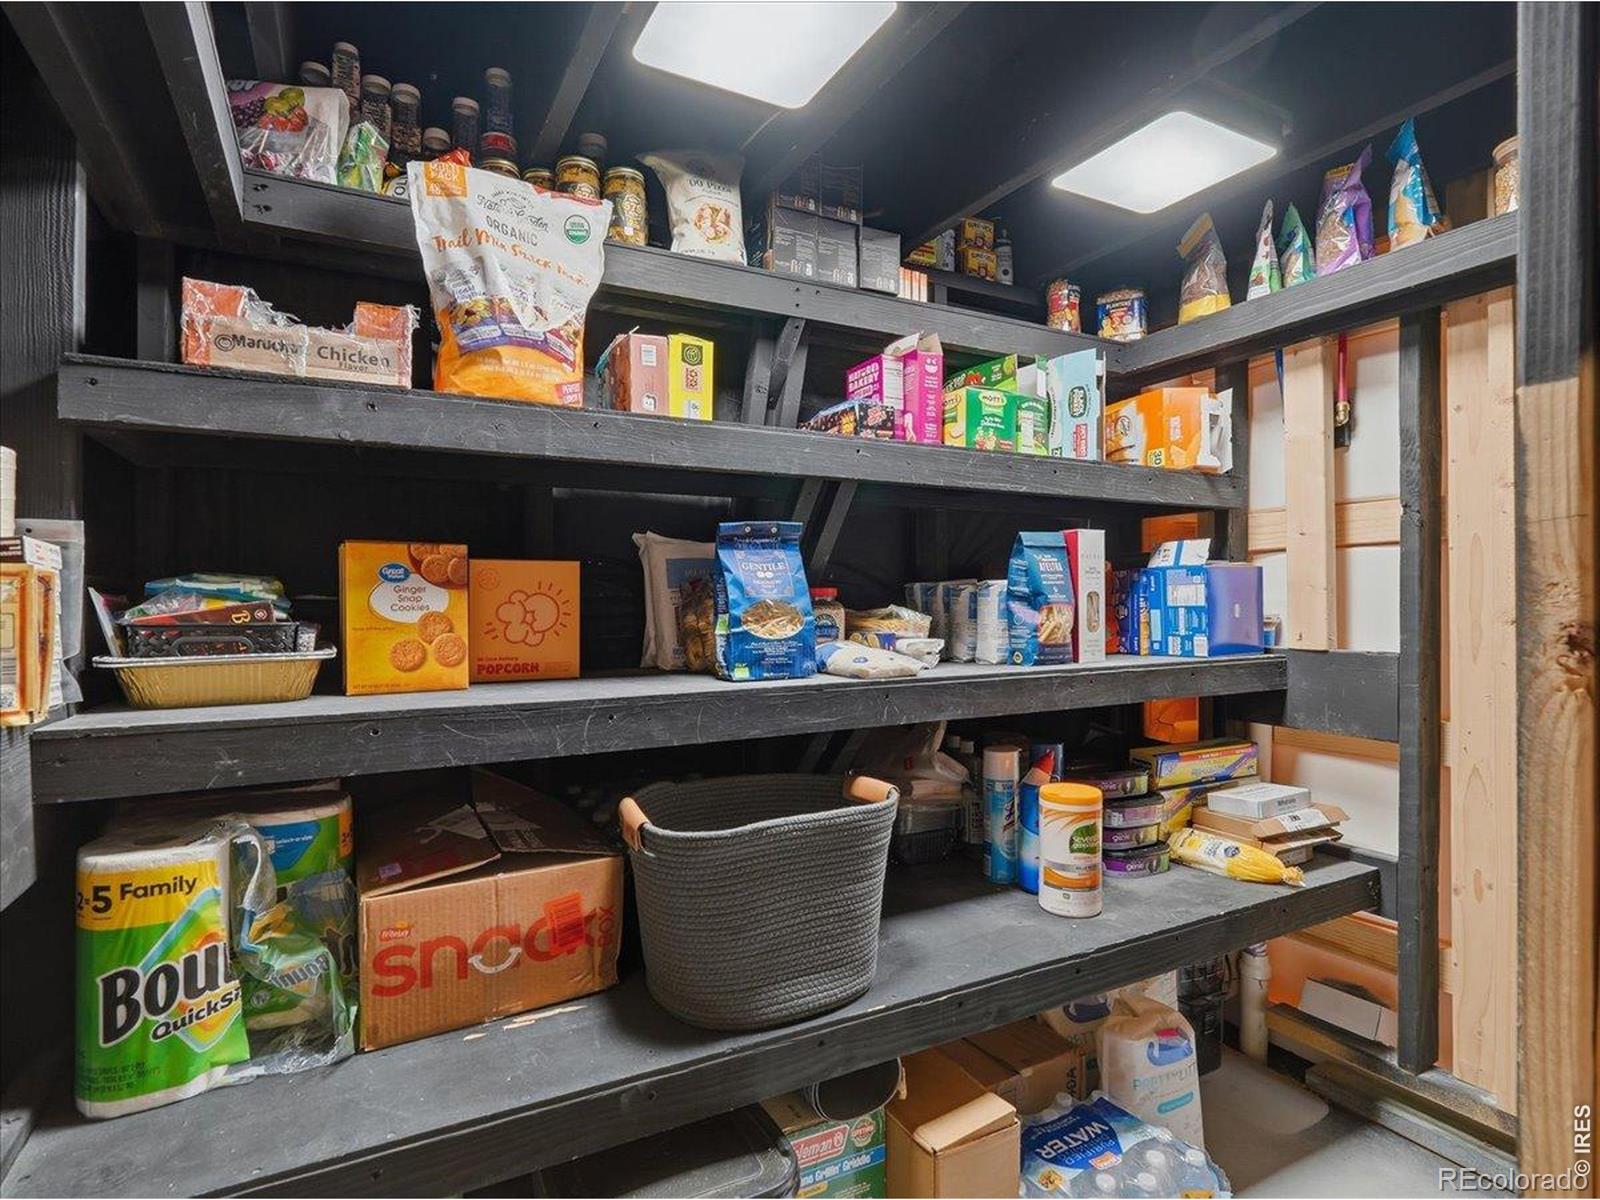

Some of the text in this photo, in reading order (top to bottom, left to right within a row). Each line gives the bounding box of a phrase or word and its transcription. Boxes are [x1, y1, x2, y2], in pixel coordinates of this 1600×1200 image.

[485, 215, 539, 247] ORGANIC
[431, 230, 472, 253] Trail
[475, 227, 507, 252] Mix
[511, 244, 552, 269] Snack
[317, 345, 391, 369] Chicken
[338, 361, 369, 373] Flavor
[741, 562, 786, 571] GENTILE
[393, 584, 426, 595] Ginger
[398, 594, 423, 603] Snap
[391, 603, 430, 611] Cookies
[476, 662, 540, 675] POPCORN
[119, 875, 198, 901] Family
[1034, 1121, 1110, 1159] WATER
[1064, 1139, 1116, 1166] PURIFIED
